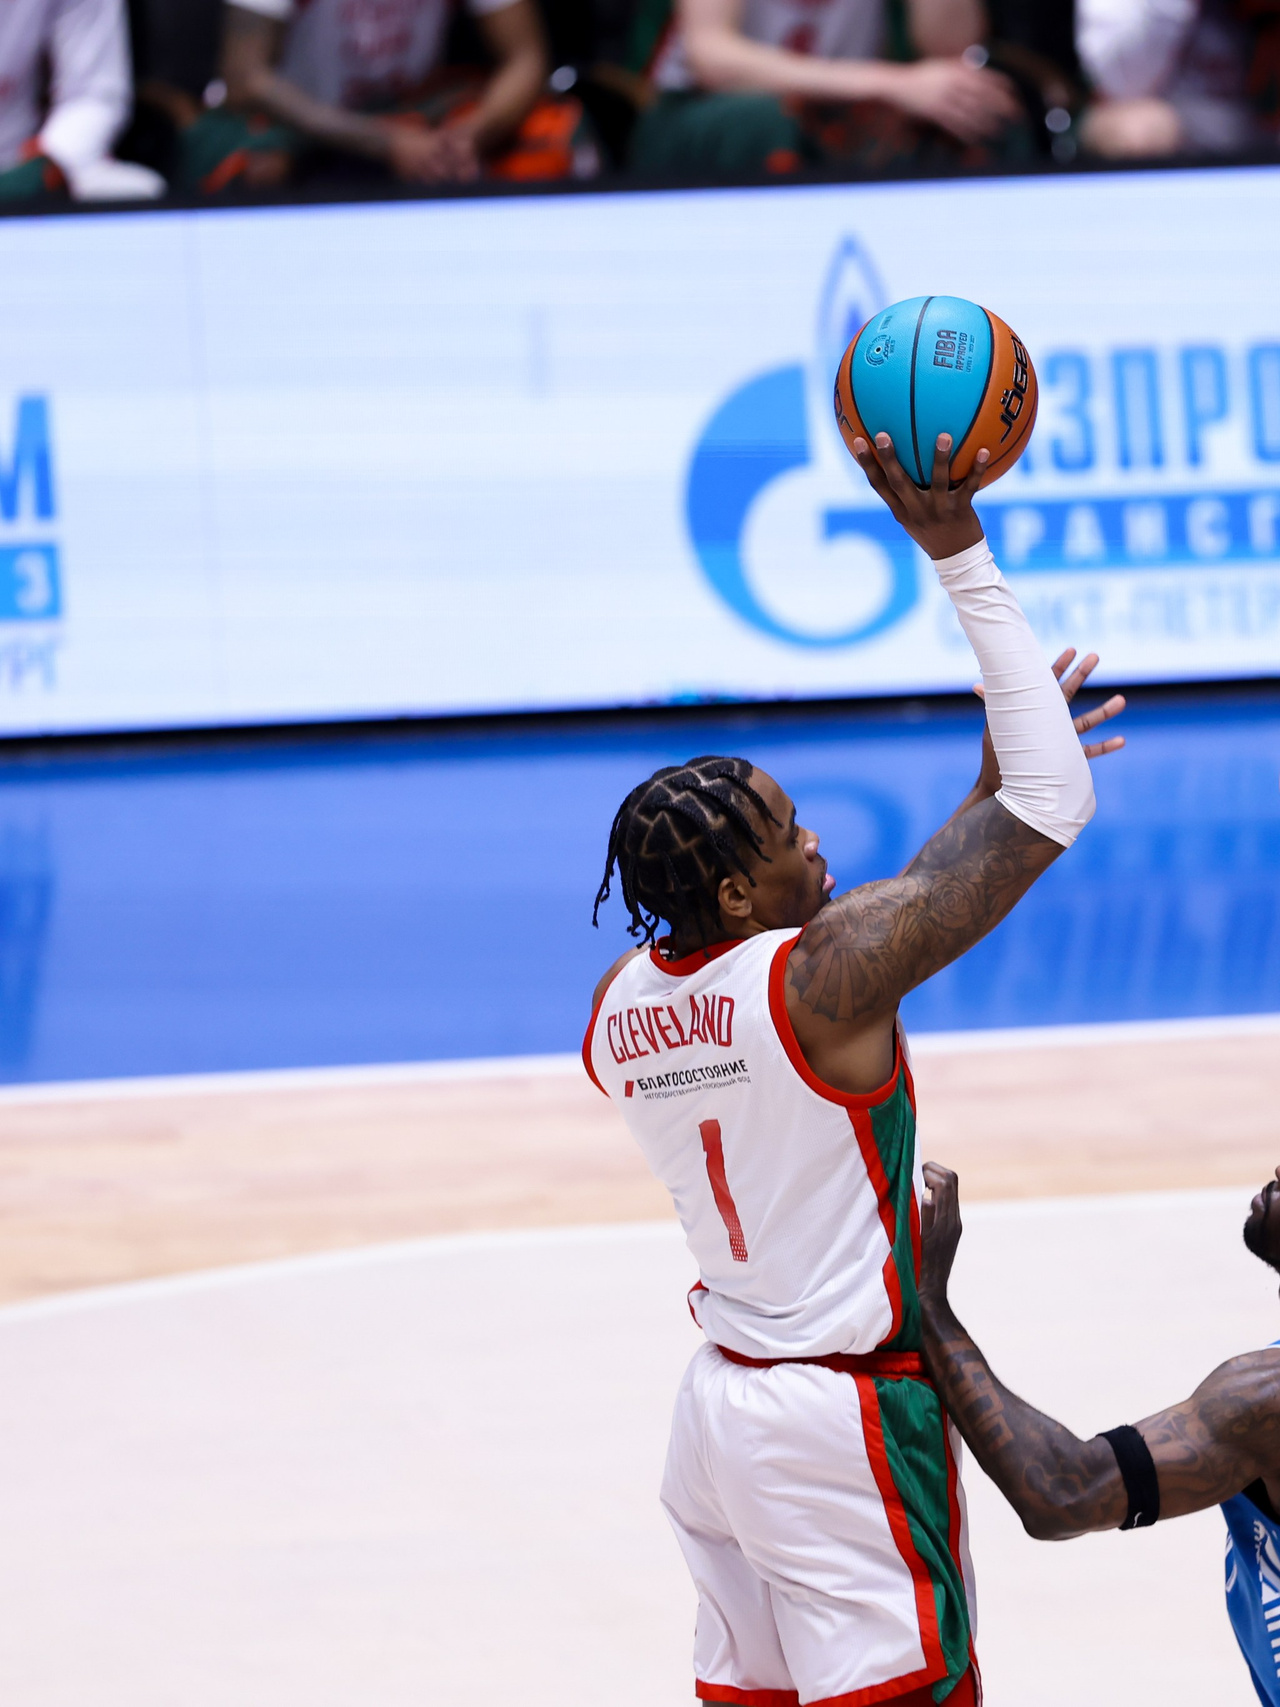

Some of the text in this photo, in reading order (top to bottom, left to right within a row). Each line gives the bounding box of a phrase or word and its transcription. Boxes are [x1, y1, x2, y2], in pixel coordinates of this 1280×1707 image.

[933, 329, 957, 369] FIBA
[955, 332, 968, 371] APPROVED
[607, 994, 734, 1064] CLEVELAND
[637, 1059, 748, 1091] БЛАГОСОСТОЯНИЕ
[699, 1119, 748, 1262] 1
